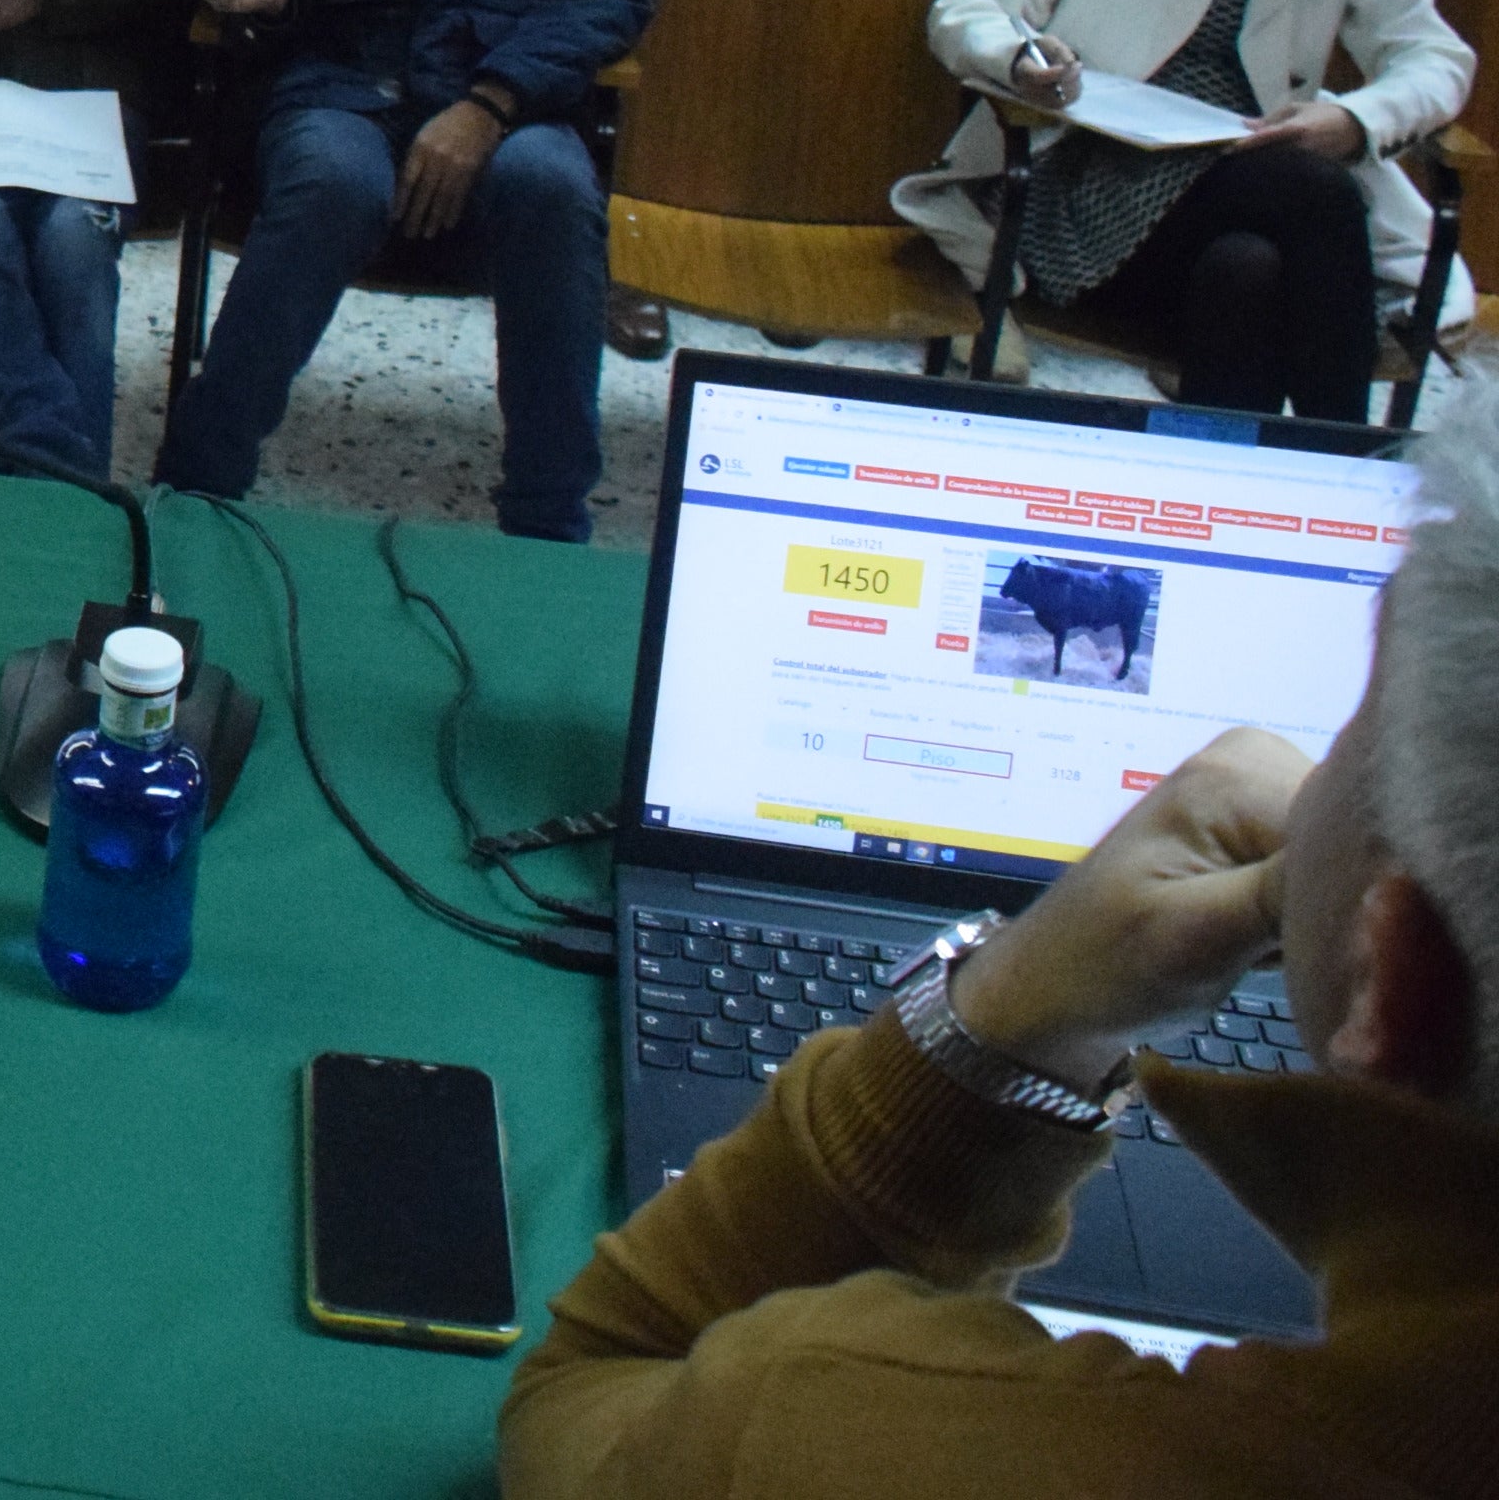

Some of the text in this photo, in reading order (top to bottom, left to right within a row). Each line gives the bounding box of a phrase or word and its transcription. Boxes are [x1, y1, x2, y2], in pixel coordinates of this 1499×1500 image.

[725, 458, 744, 470] LSL
[830, 534, 883, 550] Lote3121
[819, 562, 891, 594] 1450
[773, 657, 804, 668] Control
[826, 664, 841, 673] del
[802, 732, 825, 751] 10
[920, 749, 955, 767] Piso
[1051, 767, 1081, 782] 3128
[819, 818, 842, 831] 1450
[711, 968, 725, 980] Q
[759, 975, 775, 986] W
[806, 981, 817, 992] E
[854, 987, 867, 998] R
[725, 998, 737, 1008] A
[773, 1004, 785, 1015] S
[821, 1011, 833, 1021] D
[751, 1028, 763, 1039] Z
[1149, 1338, 1165, 1348] DE
